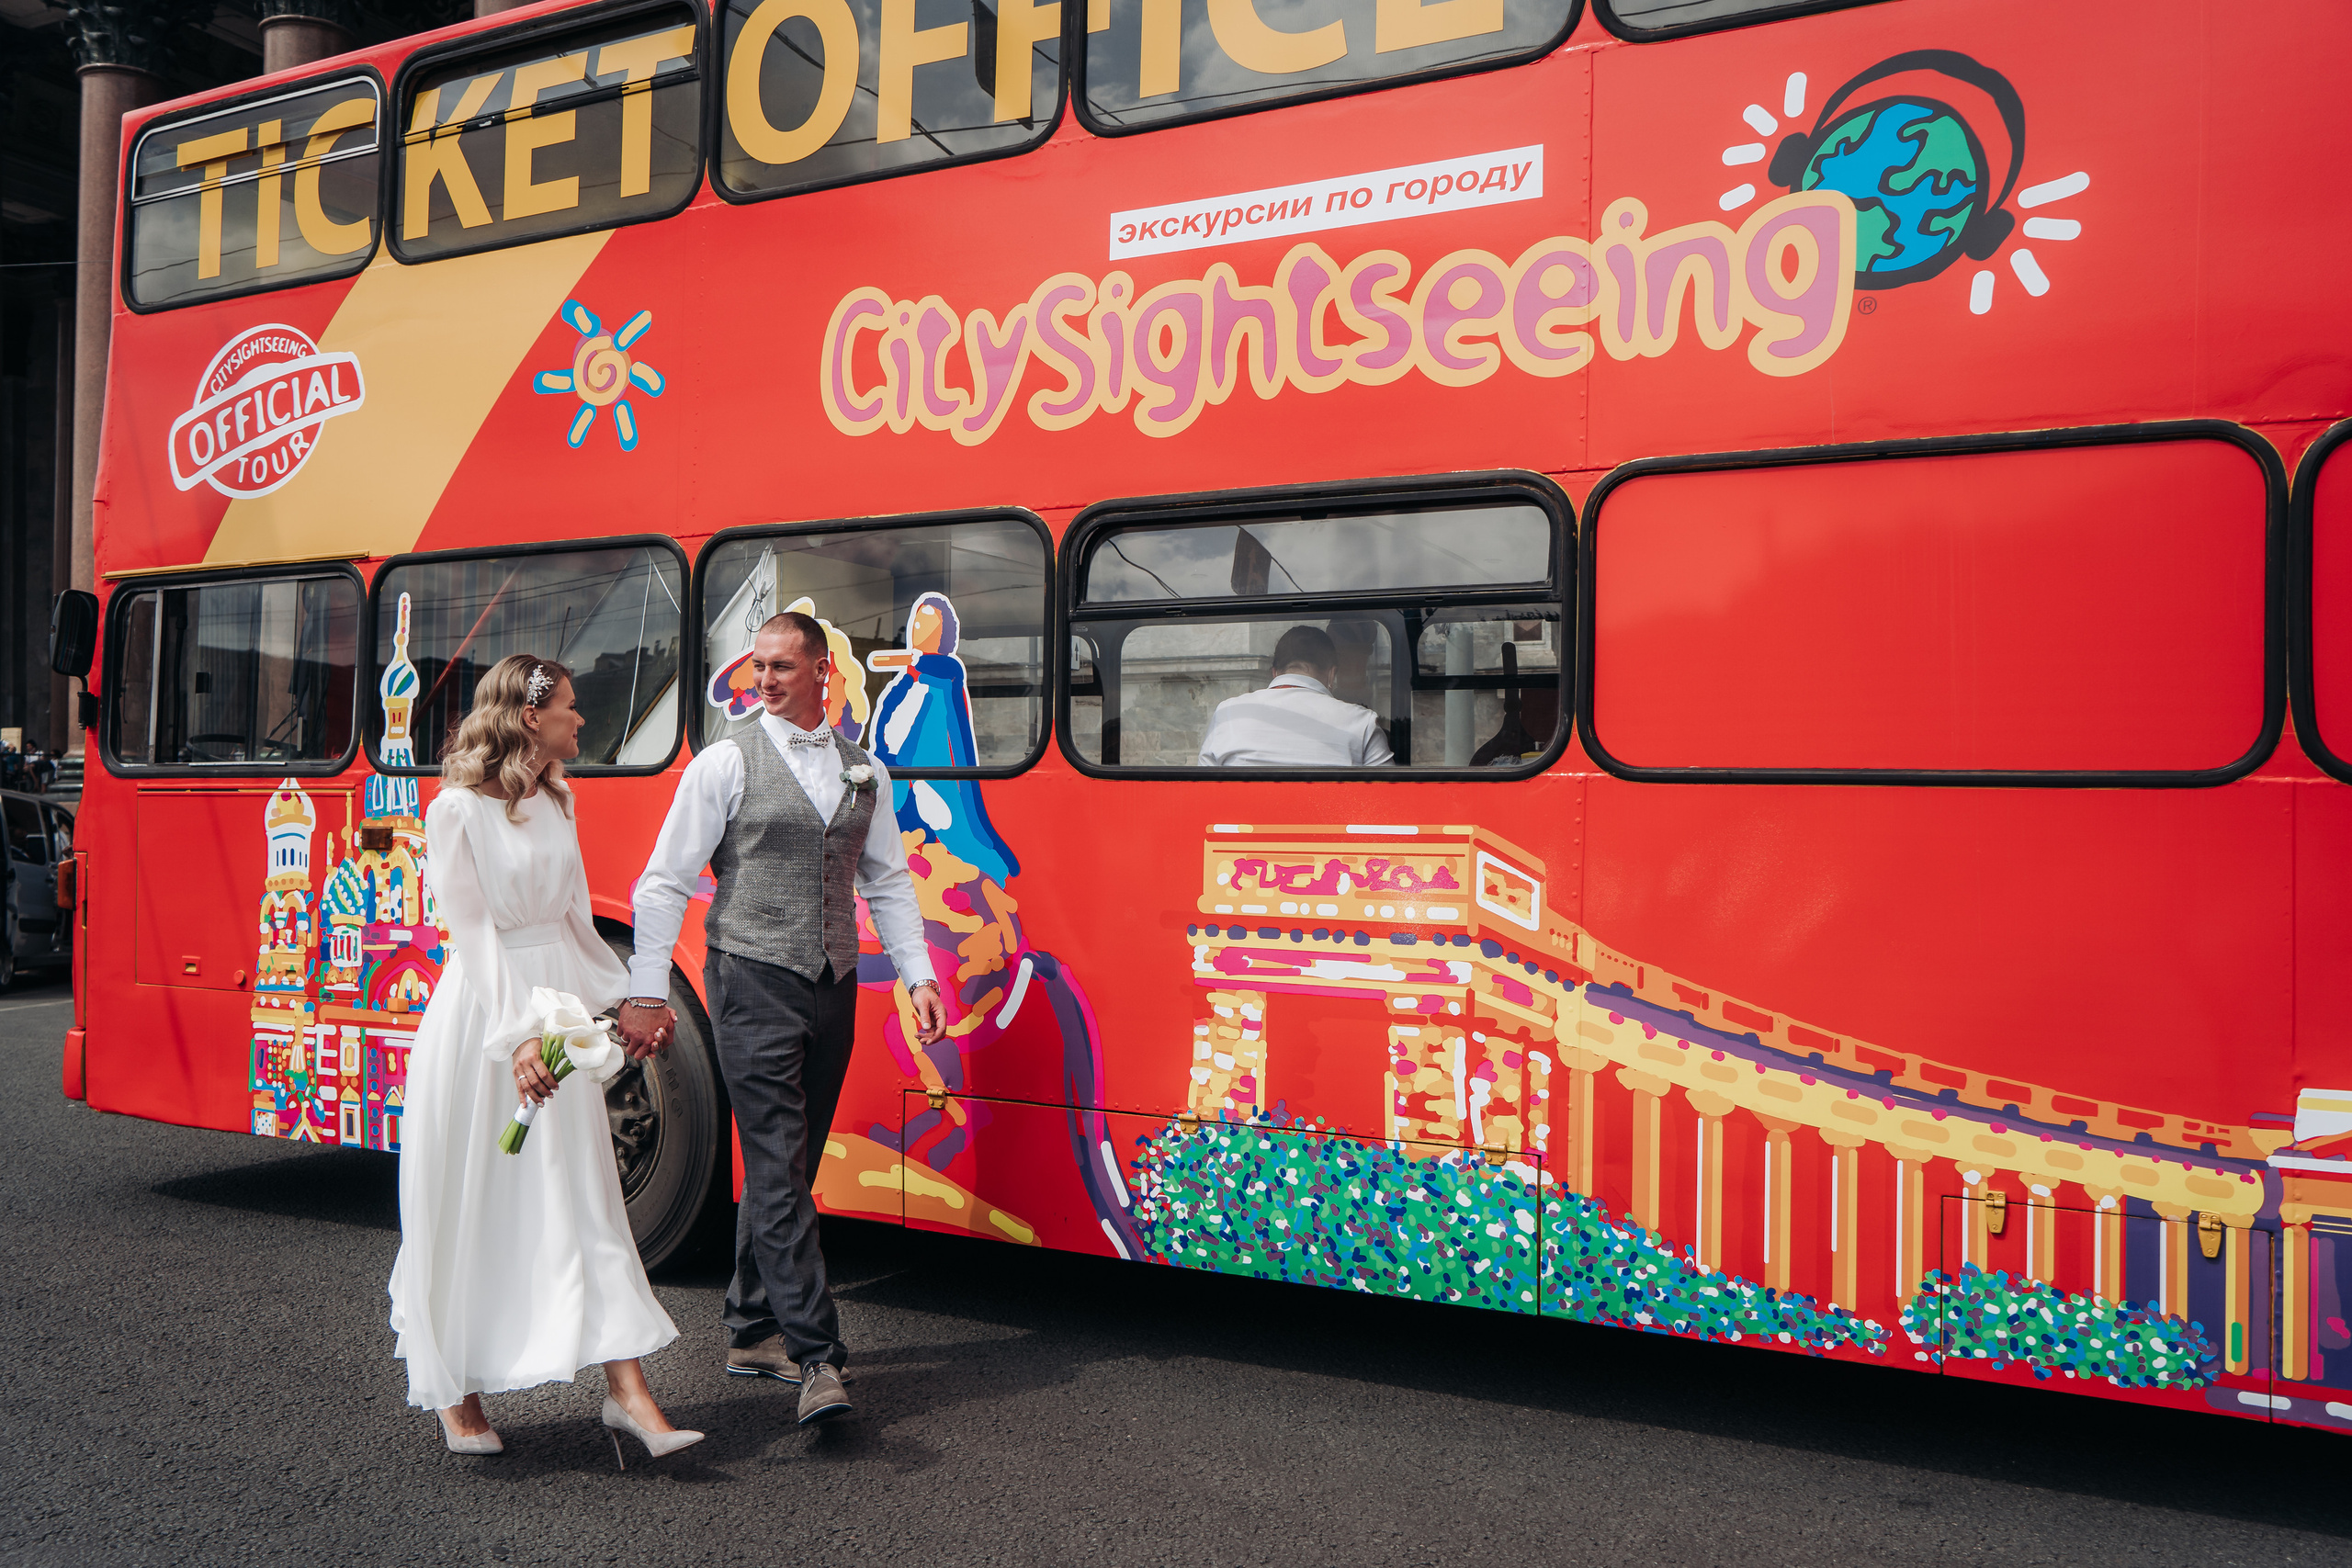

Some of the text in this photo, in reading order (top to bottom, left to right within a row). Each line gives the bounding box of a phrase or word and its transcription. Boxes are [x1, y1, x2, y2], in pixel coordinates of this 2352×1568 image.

[176, 24, 696, 280] TICKET
[1117, 161, 1533, 243] экскурсии по городу
[210, 336, 308, 395] CITYSIGHTSEEING
[189, 365, 351, 466] OFFICIAL
[238, 431, 310, 484] TOUR
